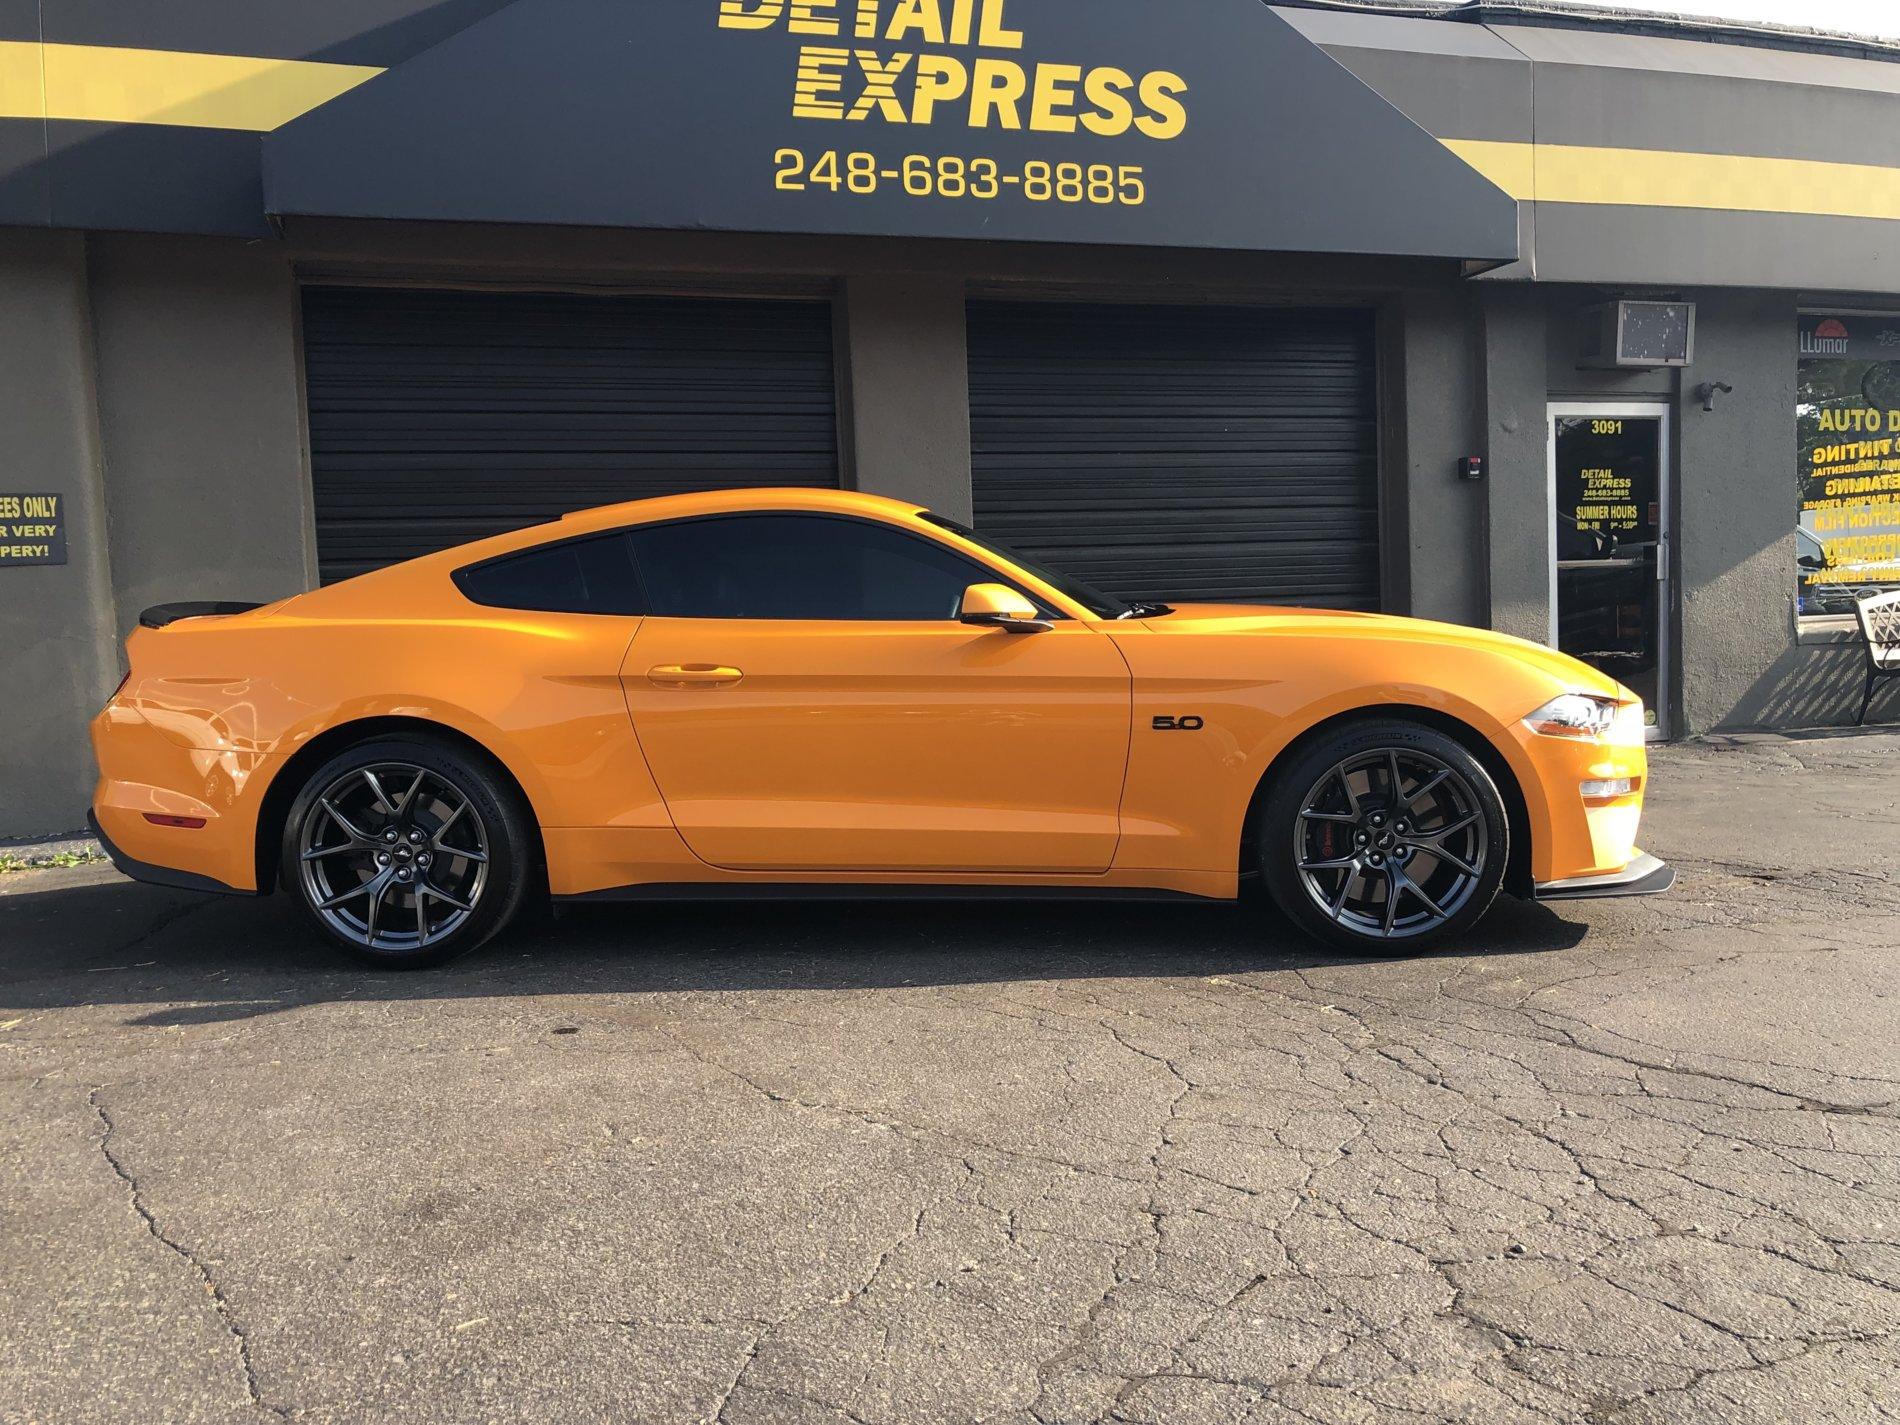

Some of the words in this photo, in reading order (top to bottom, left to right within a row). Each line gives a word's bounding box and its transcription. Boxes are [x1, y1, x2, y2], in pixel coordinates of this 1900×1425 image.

[792, 46, 1188, 139] EXPRESS
[774, 148, 1145, 206] 248-683-8885
[1592, 420, 1623, 435] 3091
[1818, 409, 1881, 432] AUTO
[1581, 469, 1613, 478] DETAIL
[1588, 479, 1631, 488] EXPRESS
[23, 496, 57, 518] ONLY
[1576, 505, 1609, 519] SUMMER
[1610, 505, 1638, 519] HOURS
[11, 525, 57, 537] VERY
[0, 545, 49, 558] PERY!
[1152, 715, 1204, 730] 5.0
